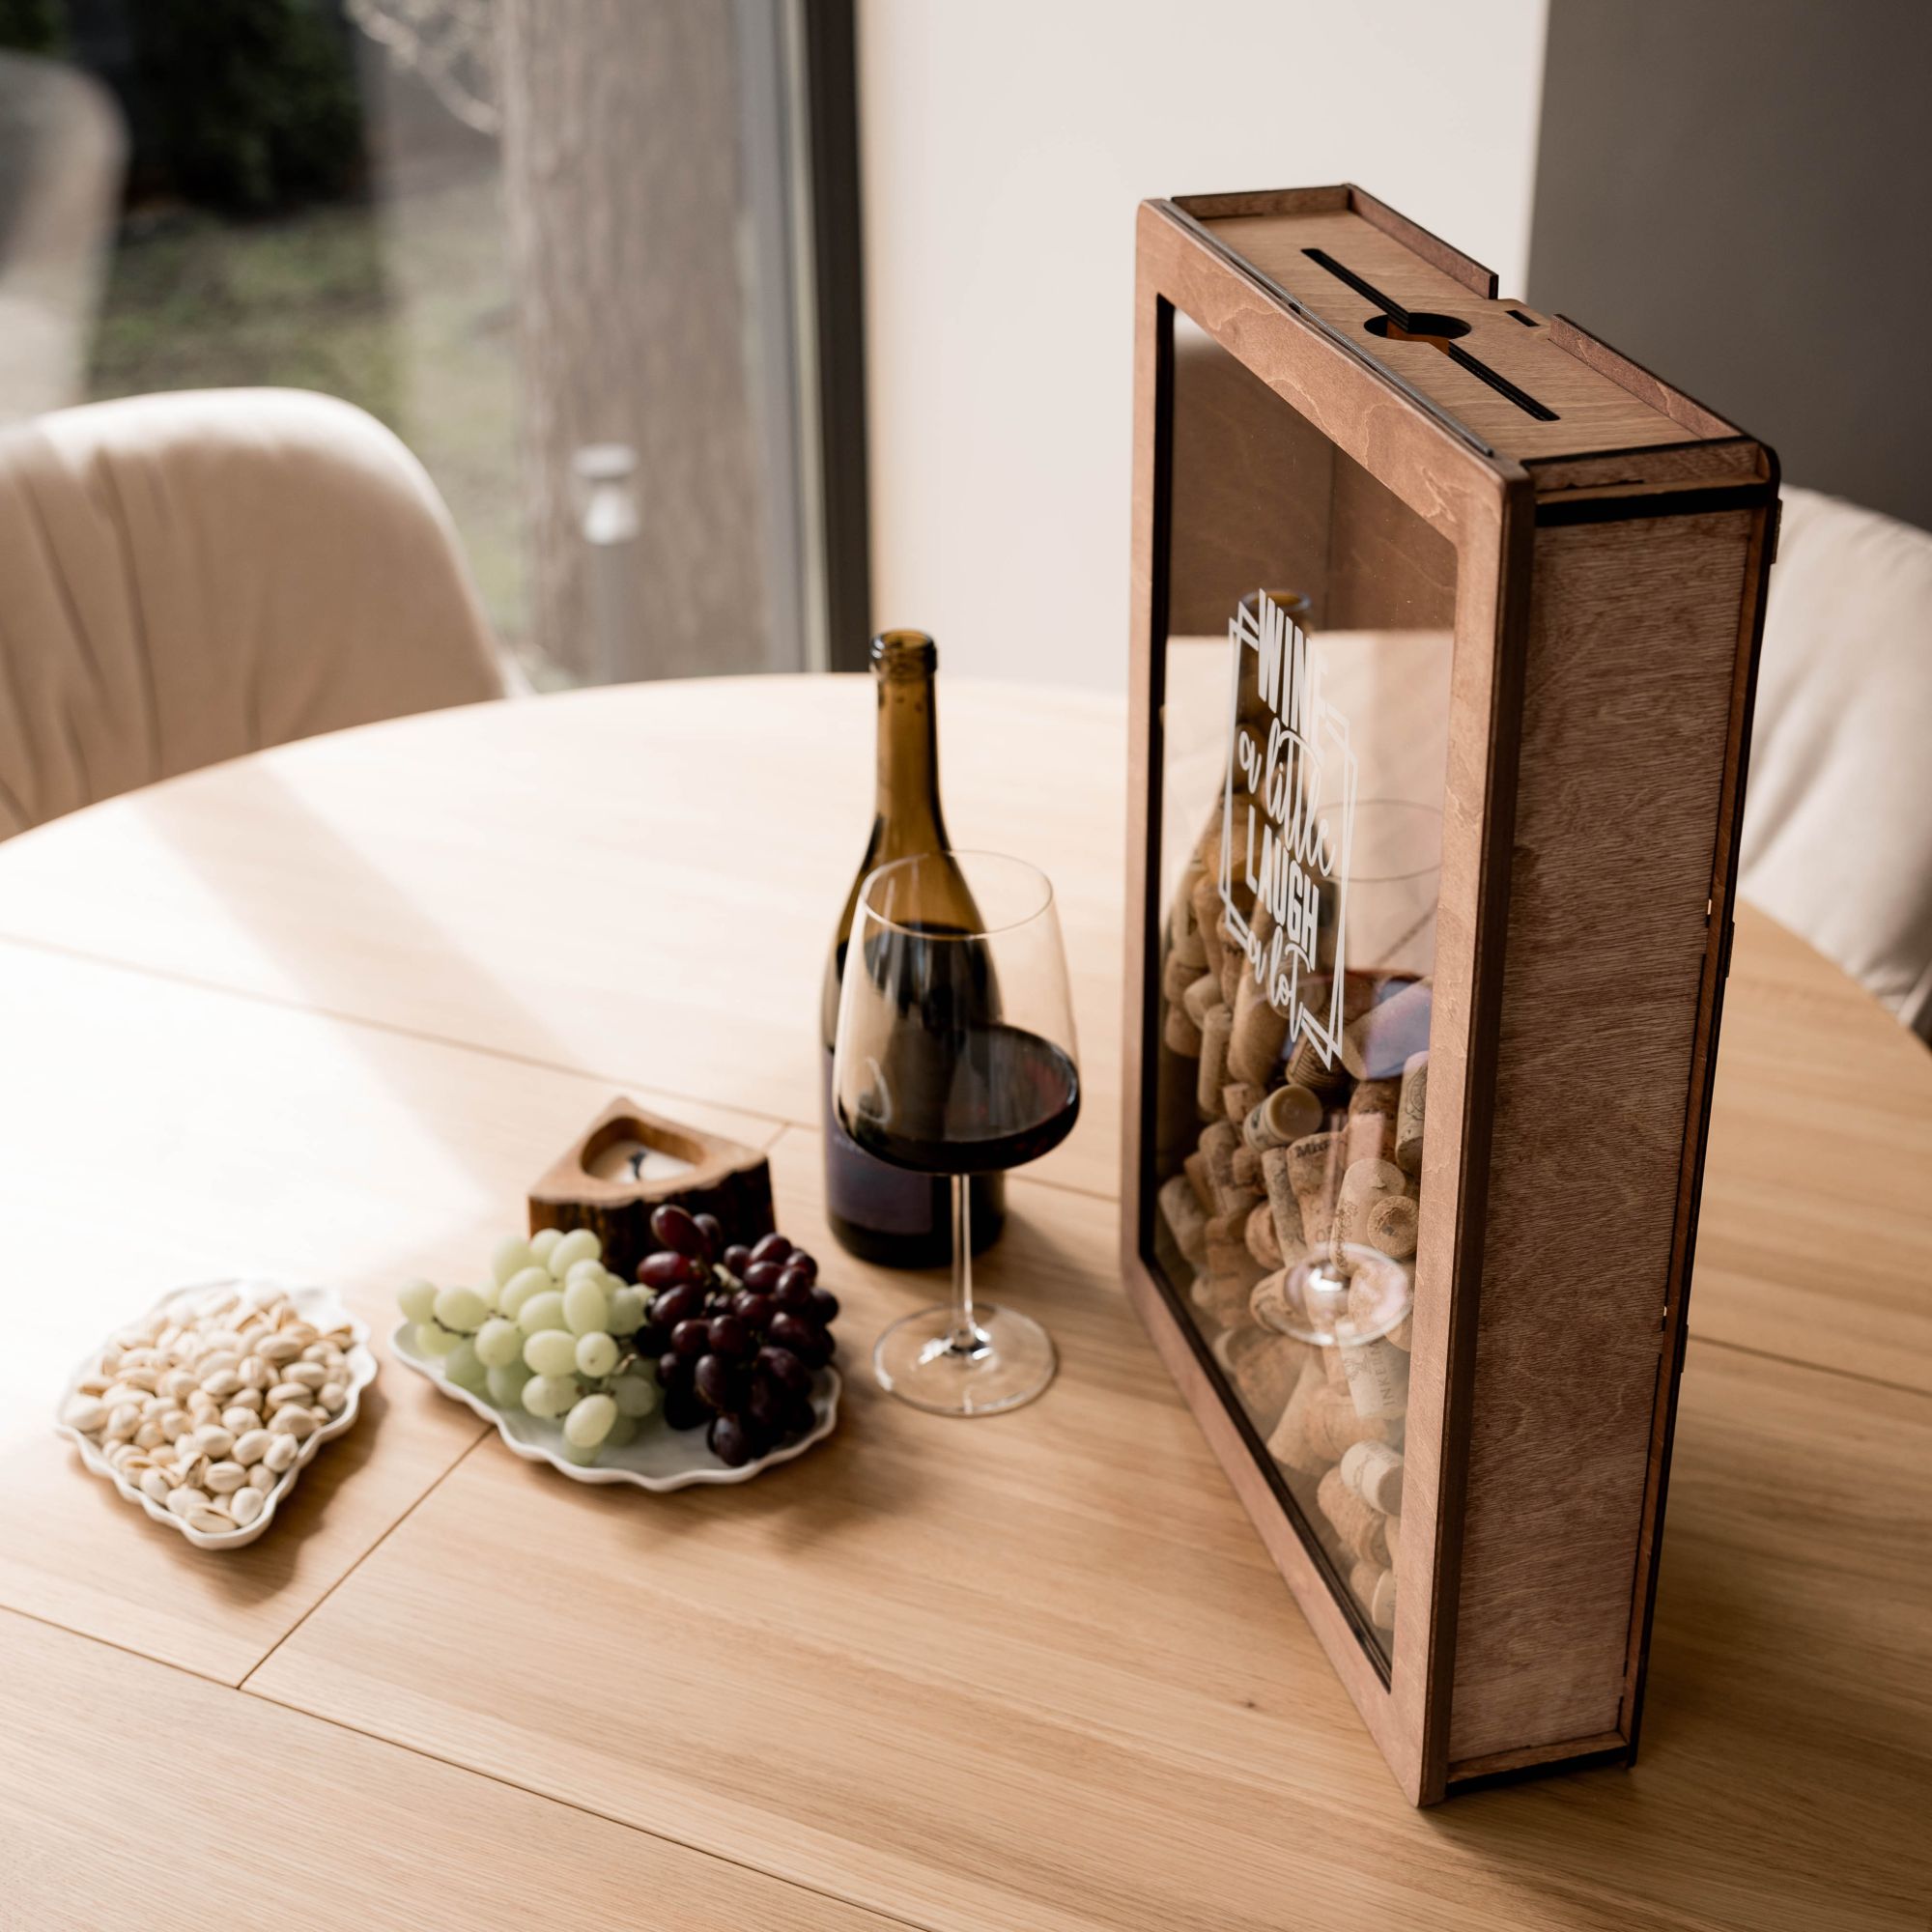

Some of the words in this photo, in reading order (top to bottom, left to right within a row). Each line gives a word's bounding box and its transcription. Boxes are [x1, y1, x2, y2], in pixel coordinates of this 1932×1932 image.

[1258, 587, 1328, 764] WINE
[1238, 730, 1262, 794] a
[1265, 717, 1337, 877] little
[1245, 804, 1320, 972] LAUGH
[1247, 930, 1267, 984] a
[1269, 924, 1311, 1043] lot
